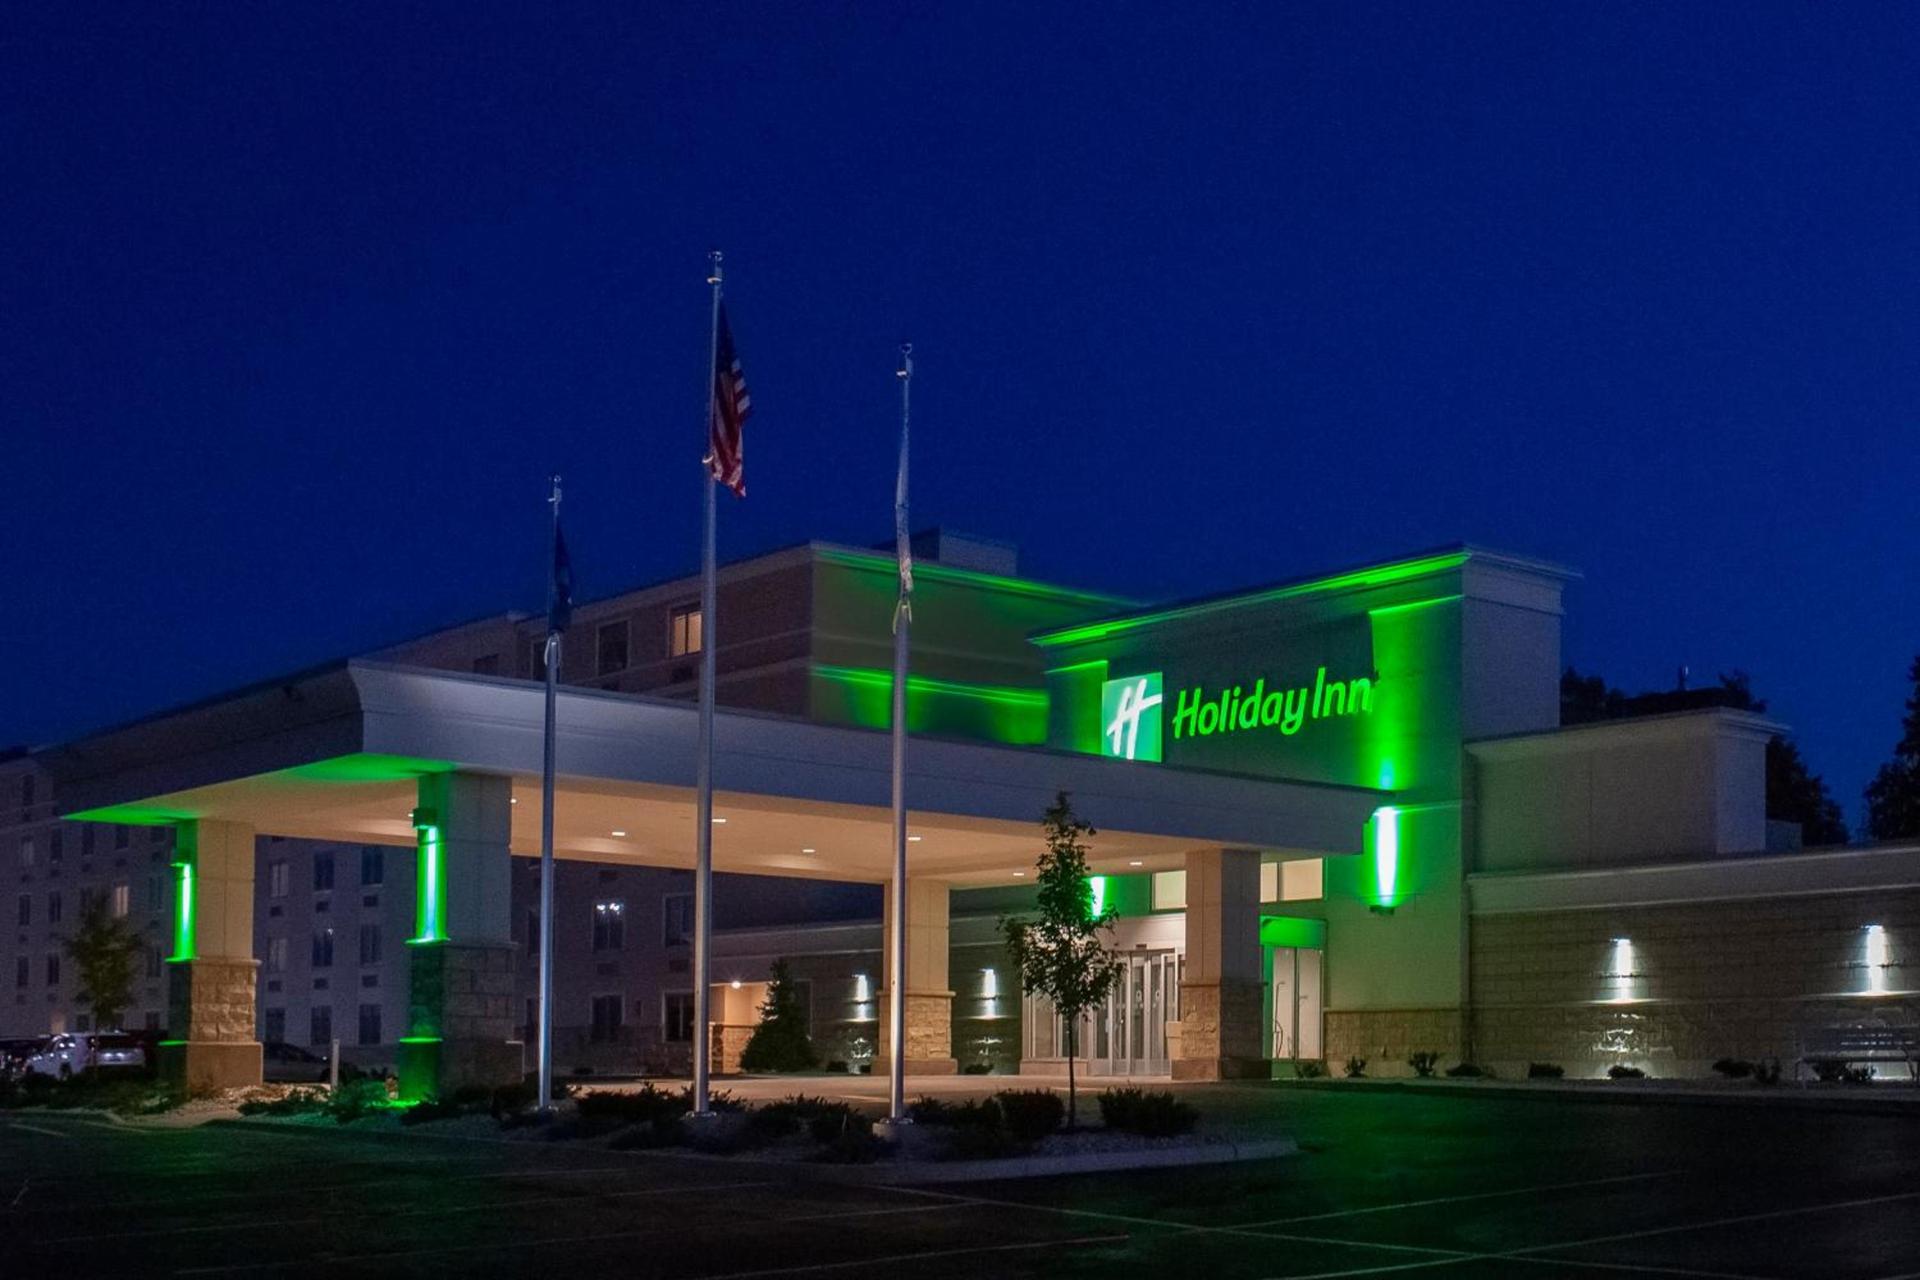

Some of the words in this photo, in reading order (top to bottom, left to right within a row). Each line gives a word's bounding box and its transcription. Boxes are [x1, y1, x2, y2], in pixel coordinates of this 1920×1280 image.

[1106, 678, 1162, 760] H
[1172, 678, 1307, 739] Holiday
[1311, 666, 1373, 719] Inn
